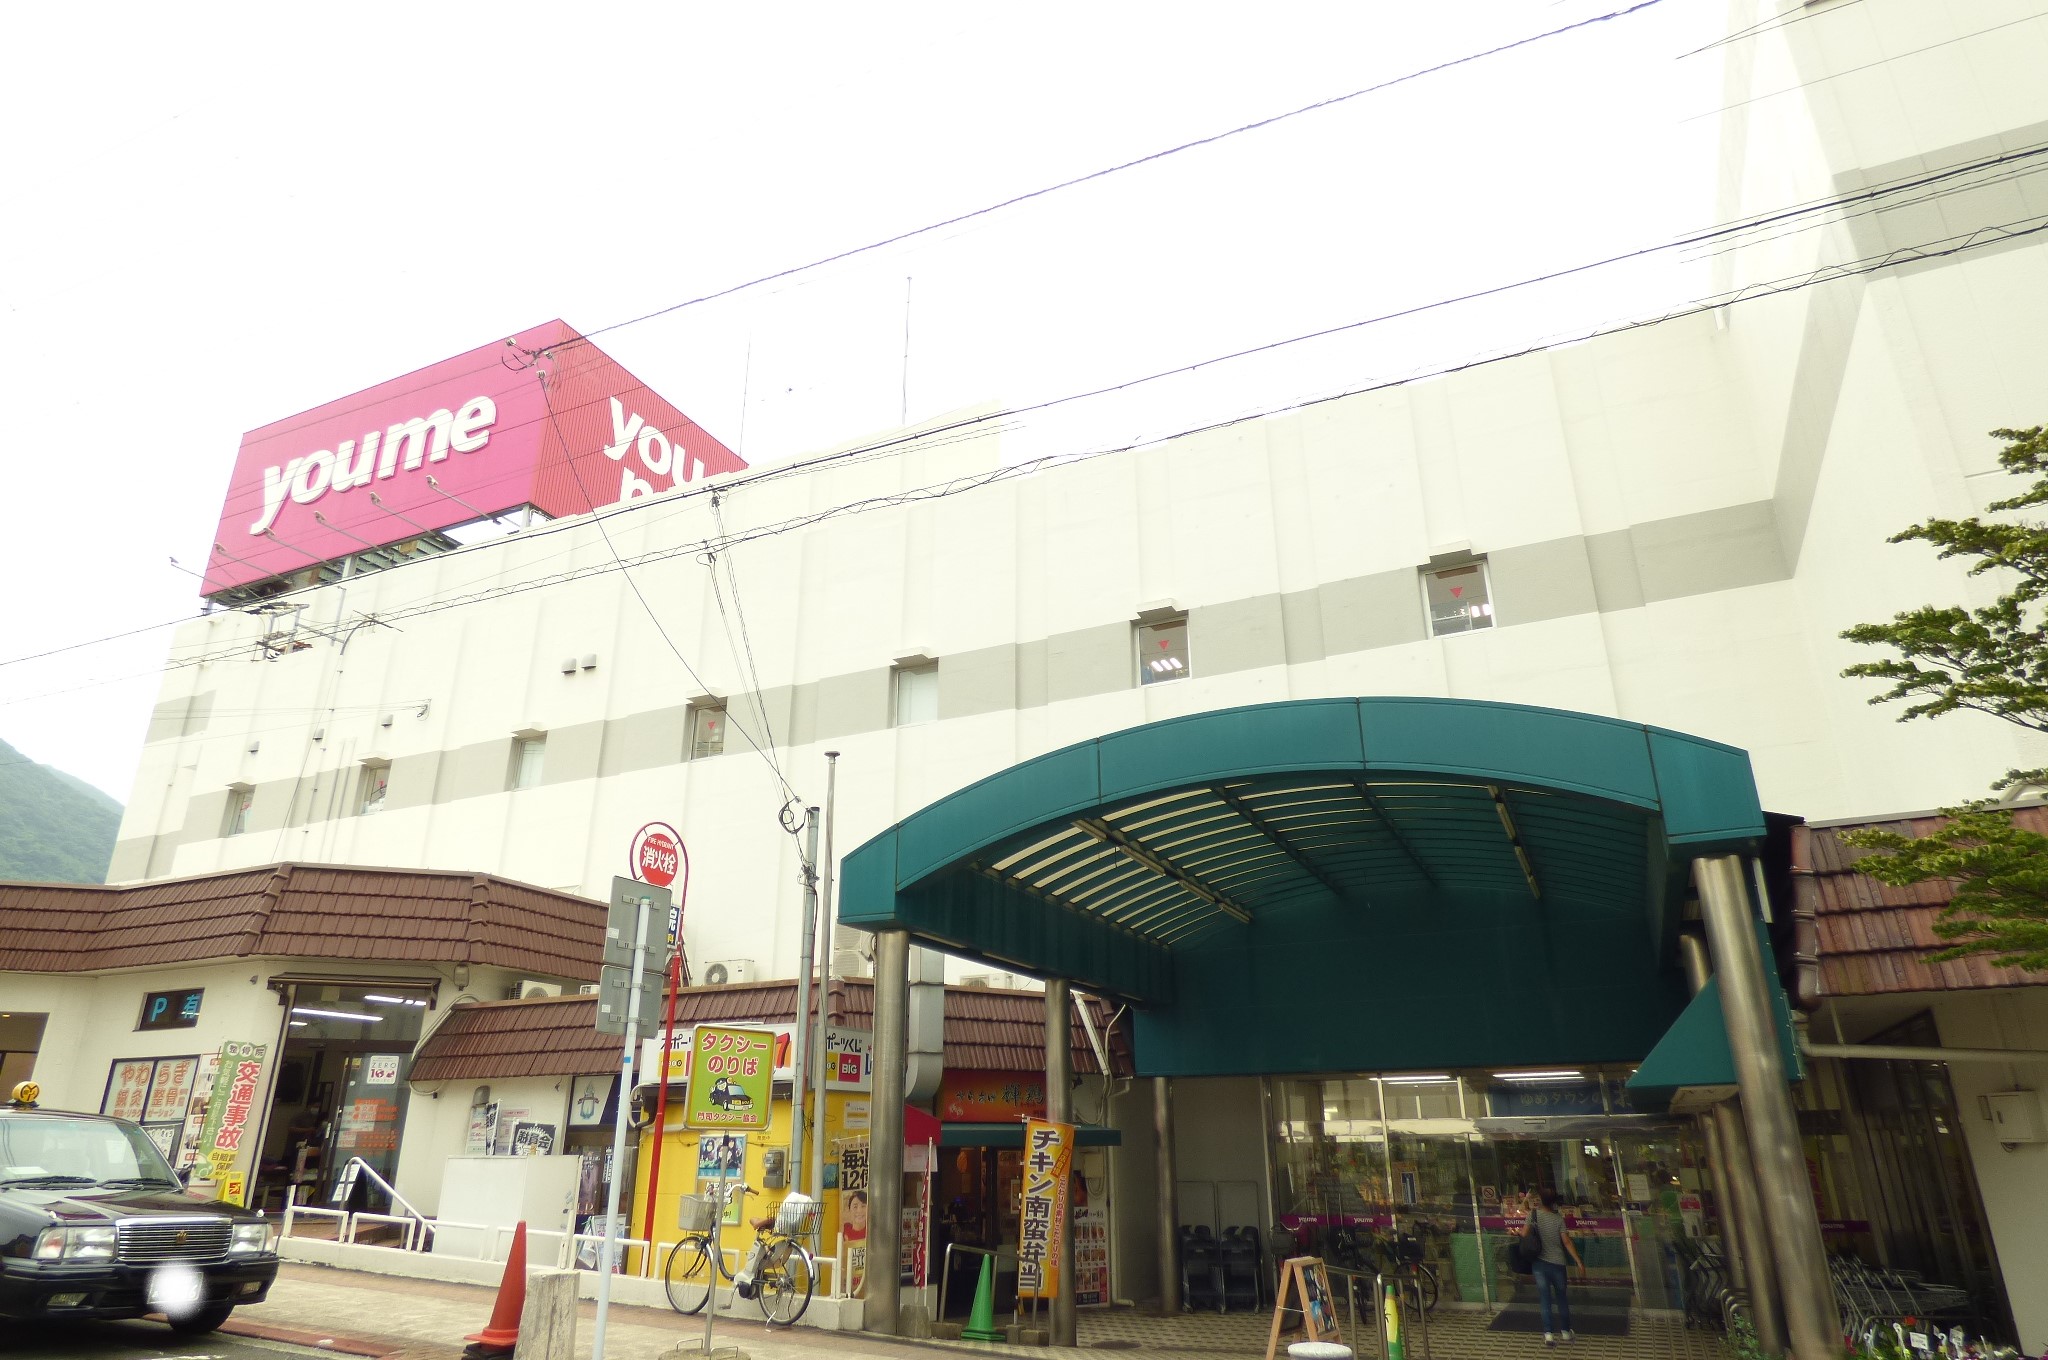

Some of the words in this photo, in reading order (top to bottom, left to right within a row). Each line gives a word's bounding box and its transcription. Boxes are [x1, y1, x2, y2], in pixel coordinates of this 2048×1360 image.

[604, 396, 705, 487] you
[250, 396, 497, 536] youme
[641, 845, 677, 875] 消火栓
[150, 997, 168, 1022] P
[180, 994, 201, 1018] 有
[702, 1032, 767, 1054] タクシー
[707, 1055, 759, 1077] のりば
[214, 1060, 262, 1151] 交通事故
[696, 1111, 758, 1124] 門司タクシー協会
[1018, 1128, 1062, 1291] チキン南蛮弁当
[1353, 1216, 1374, 1224] youme
[1575, 1219, 1598, 1227] youme
